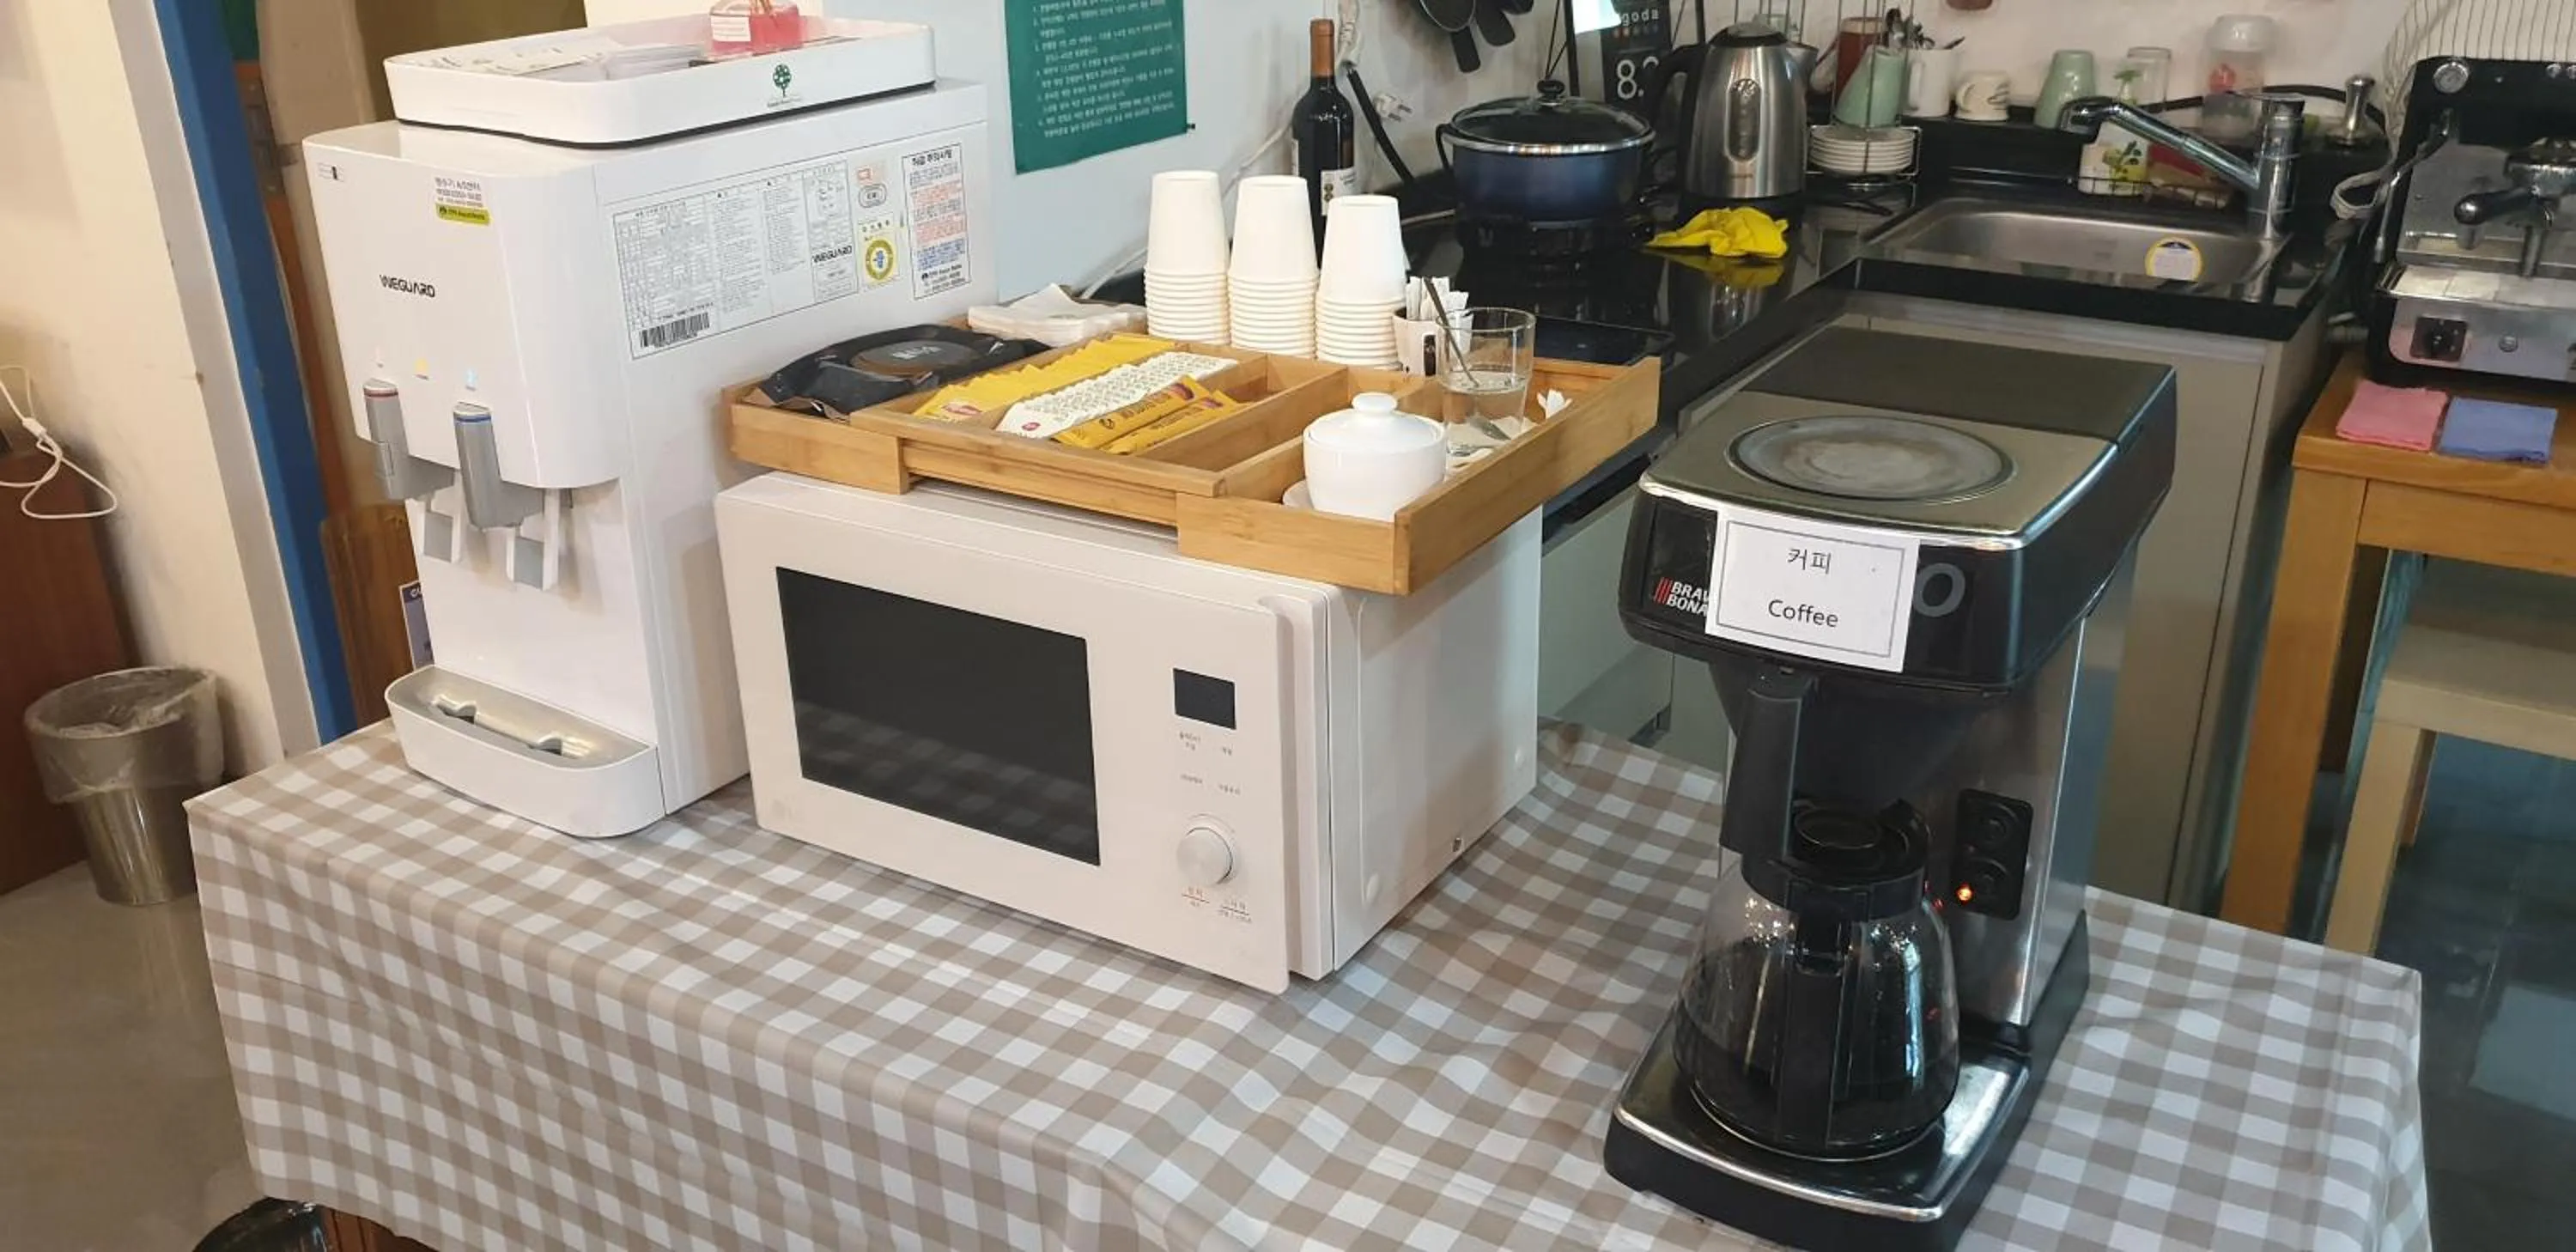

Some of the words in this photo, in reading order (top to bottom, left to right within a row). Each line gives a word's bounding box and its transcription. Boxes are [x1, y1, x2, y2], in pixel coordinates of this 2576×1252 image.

[1620, 9, 1660, 27] goda
[379, 274, 435, 298] WEGUARD
[1788, 548, 1832, 574] 커피
[1768, 599, 1839, 628] Coffee
